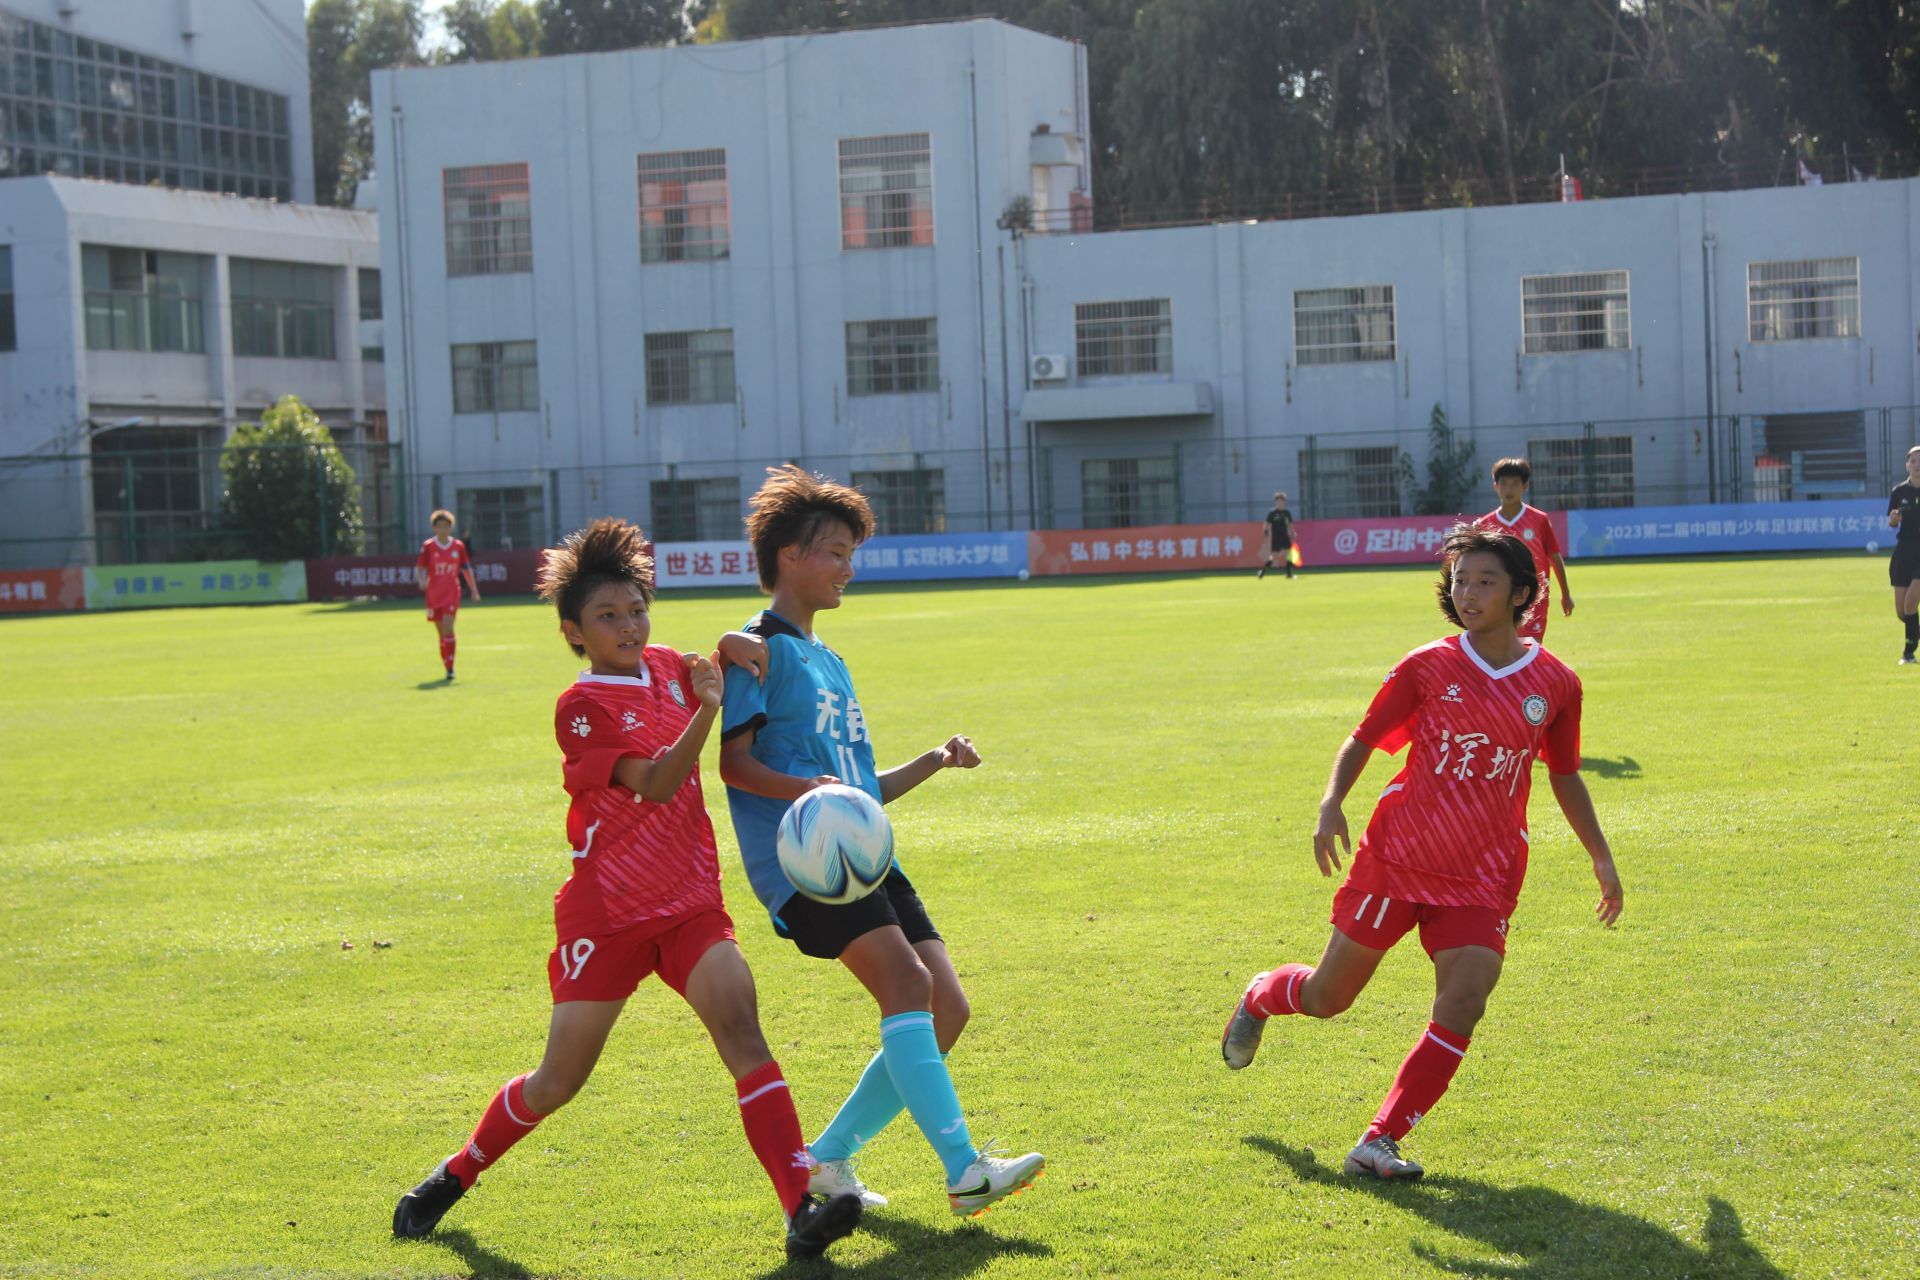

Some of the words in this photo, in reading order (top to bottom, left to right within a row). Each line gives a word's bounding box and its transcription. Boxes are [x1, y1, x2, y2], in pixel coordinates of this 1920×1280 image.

[903, 544, 1008, 567] 实现伟大梦想
[1070, 535, 1243, 562] 弘扬中华体育精神
[1334, 529, 1358, 555] @
[1440, 695, 1464, 703] KELME
[836, 744, 863, 785] 11
[1435, 729, 1529, 797] 深圳
[1354, 894, 1390, 929] 11
[560, 938, 596, 980] 19
